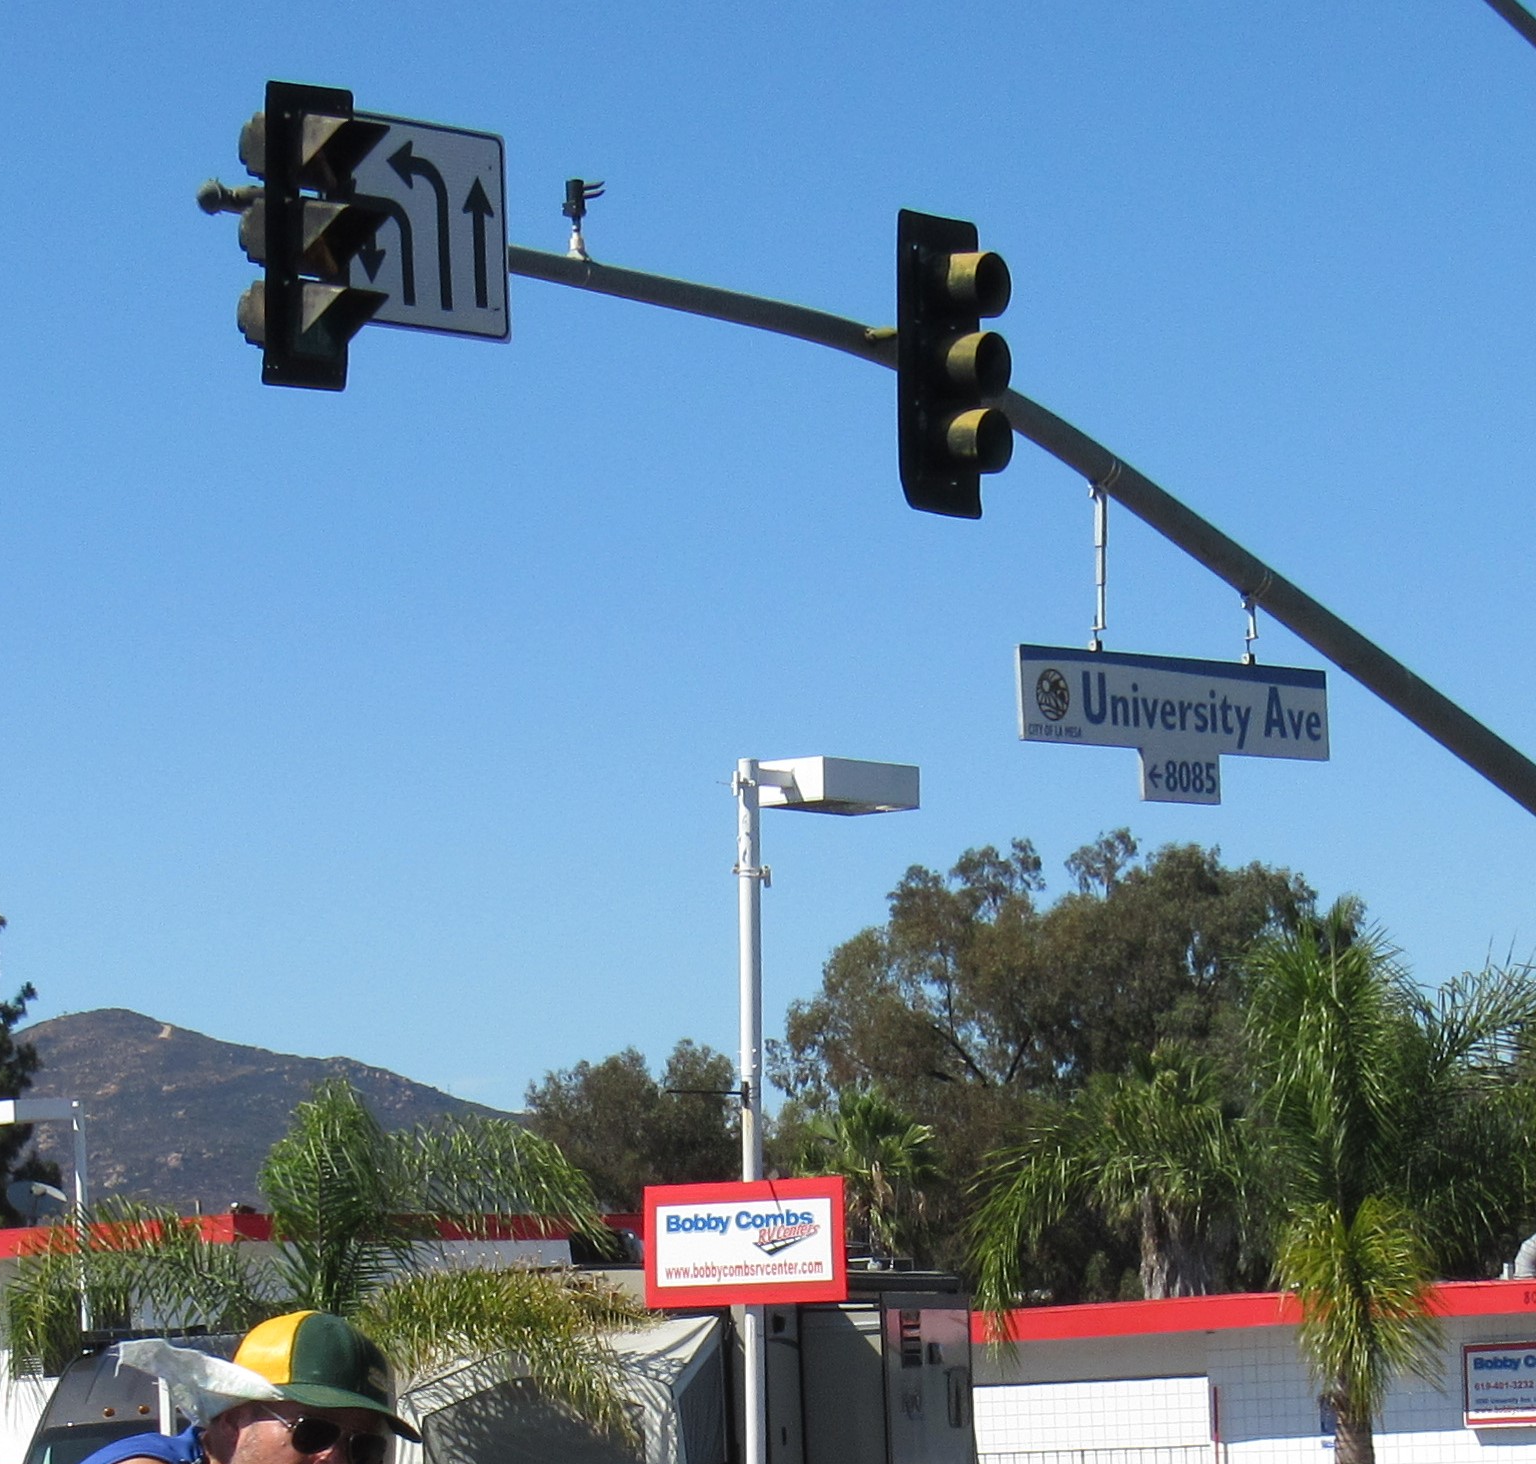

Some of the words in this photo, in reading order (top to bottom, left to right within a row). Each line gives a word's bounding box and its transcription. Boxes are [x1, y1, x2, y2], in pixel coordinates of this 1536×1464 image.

[1081, 670, 1252, 749] University
[1263, 685, 1322, 742] Ave
[1028, 724, 1043, 736] CITY
[1044, 725, 1053, 737] OF
[1054, 725, 1063, 738] LA
[1064, 726, 1082, 738] MESA
[1164, 760, 1216, 794] 8085
[666, 1213, 731, 1235] Bobby
[735, 1208, 813, 1231] Combs
[758, 1226, 776, 1245] RV
[776, 1223, 820, 1240] Centers
[665, 1260, 823, 1282] www.bobbycombsrvcenter.com
[1473, 1355, 1521, 1371] Bobby
